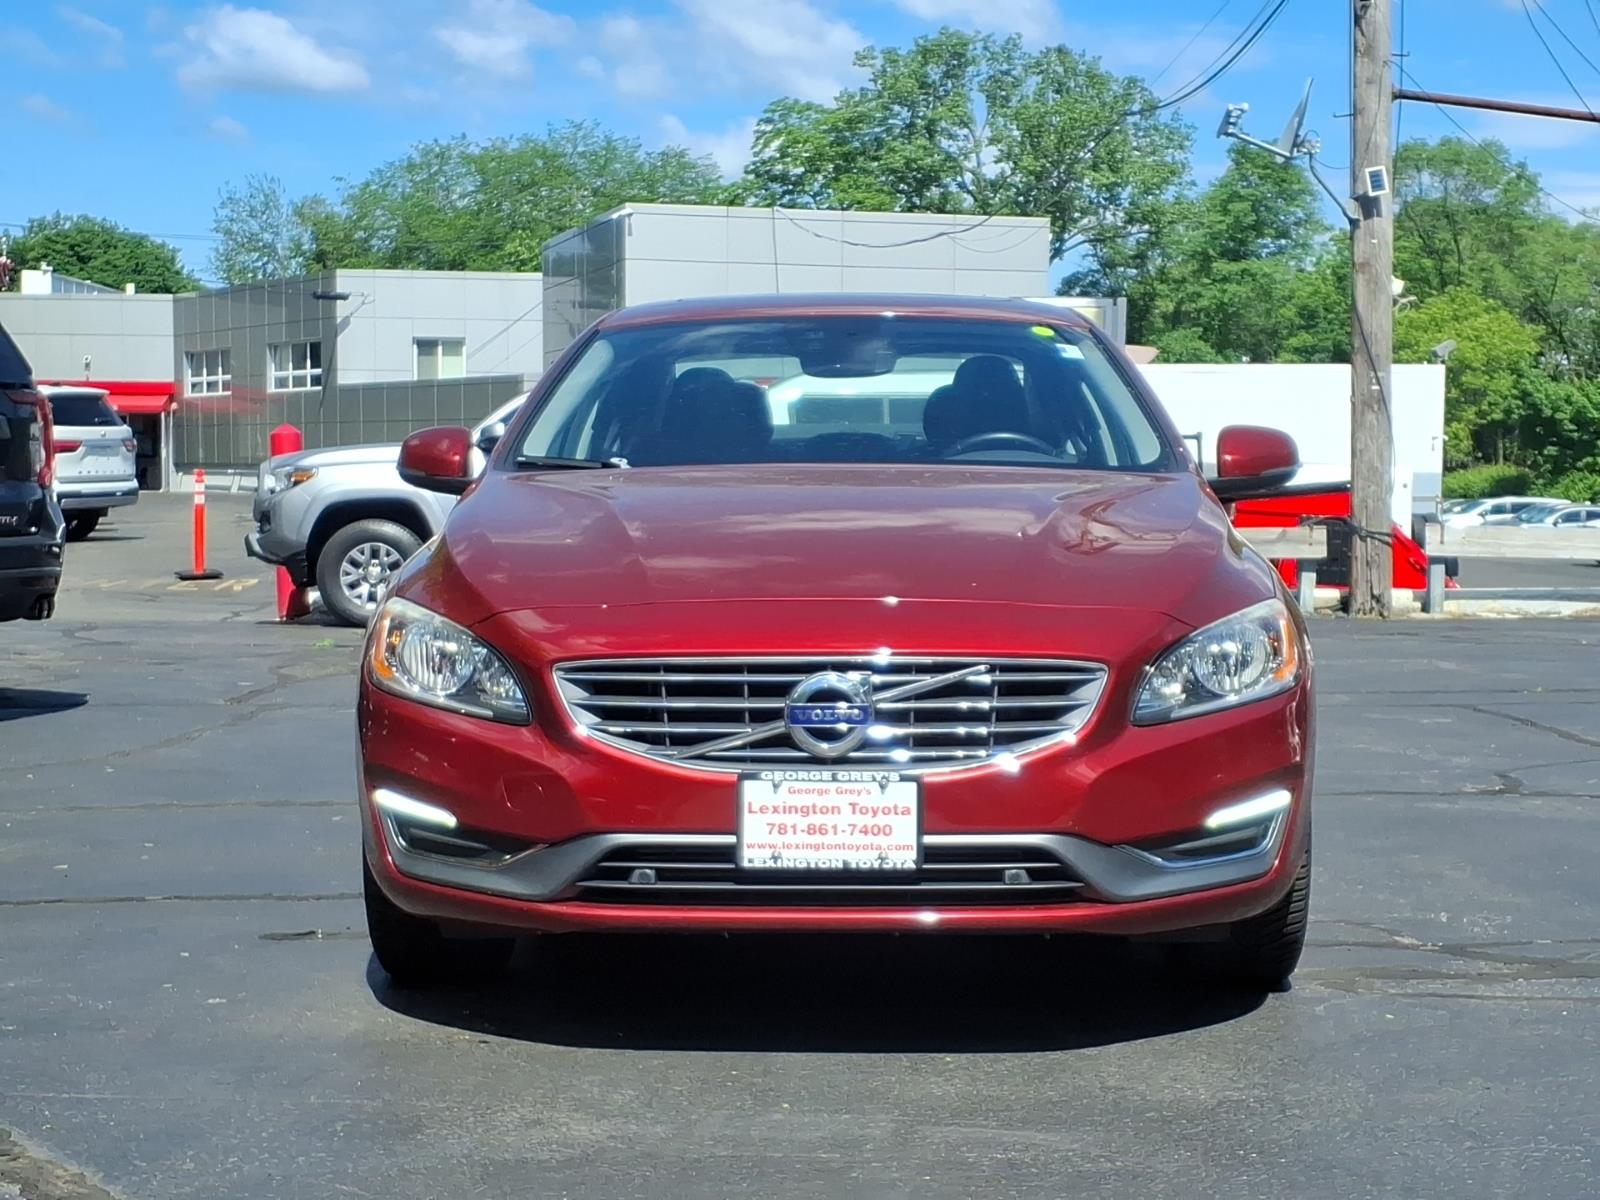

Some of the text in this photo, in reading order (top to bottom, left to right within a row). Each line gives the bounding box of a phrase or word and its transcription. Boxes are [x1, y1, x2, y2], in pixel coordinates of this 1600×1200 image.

[760, 771, 833, 781] GEORGE
[788, 786, 872, 796] George Grey's
[747, 801, 912, 817] Lexington Toyota
[766, 823, 893, 836] 781-861-7400
[746, 841, 914, 852] www.lexingtontoyota.com
[743, 857, 916, 869] LEXINGTON TOYOTA
